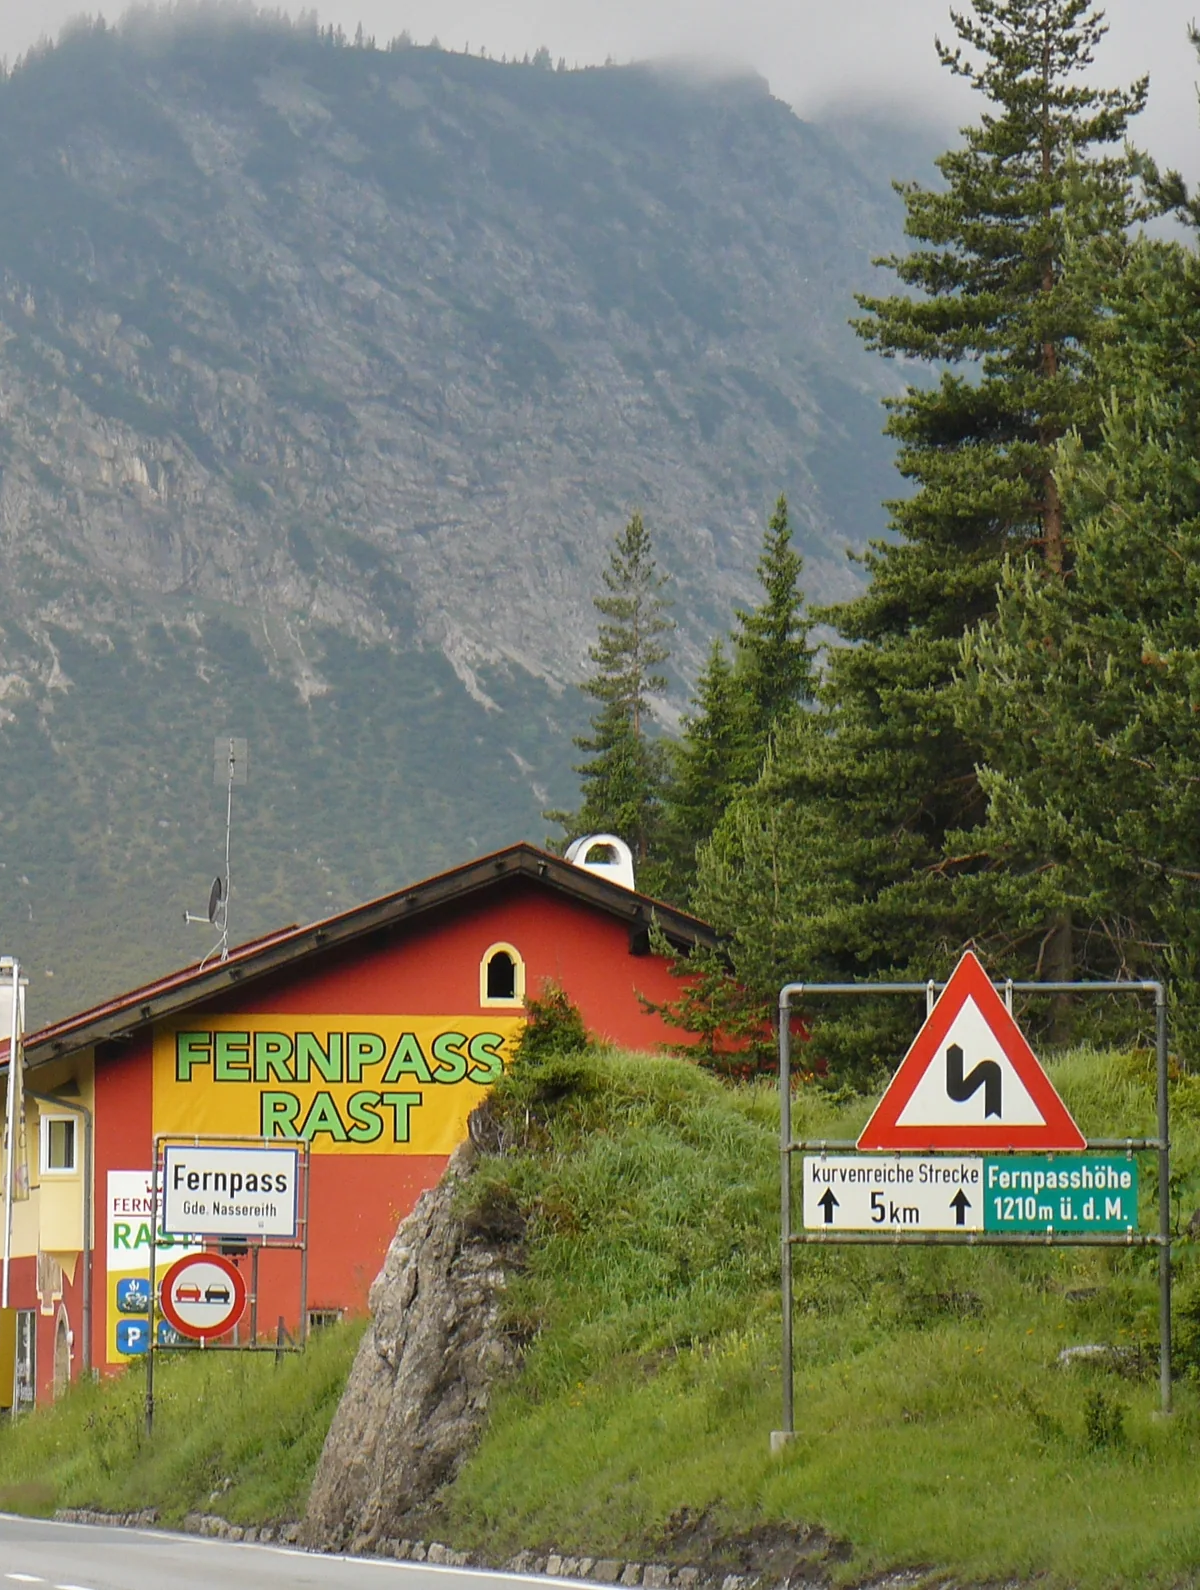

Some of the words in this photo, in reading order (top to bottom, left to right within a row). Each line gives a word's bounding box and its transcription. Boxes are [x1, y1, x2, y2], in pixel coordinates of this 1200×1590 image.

[175, 1031, 505, 1084] FERNPASS
[260, 1091, 423, 1142] RAST
[173, 1164, 288, 1199] Fernpass
[812, 1163, 914, 1184] kurvenreiche
[919, 1164, 979, 1184] Strecke
[988, 1165, 1132, 1194] Fernpasshöhe
[113, 1198, 163, 1212] FERNP
[212, 1201, 277, 1218] Nassereith
[127, 1327, 141, 1347] P
